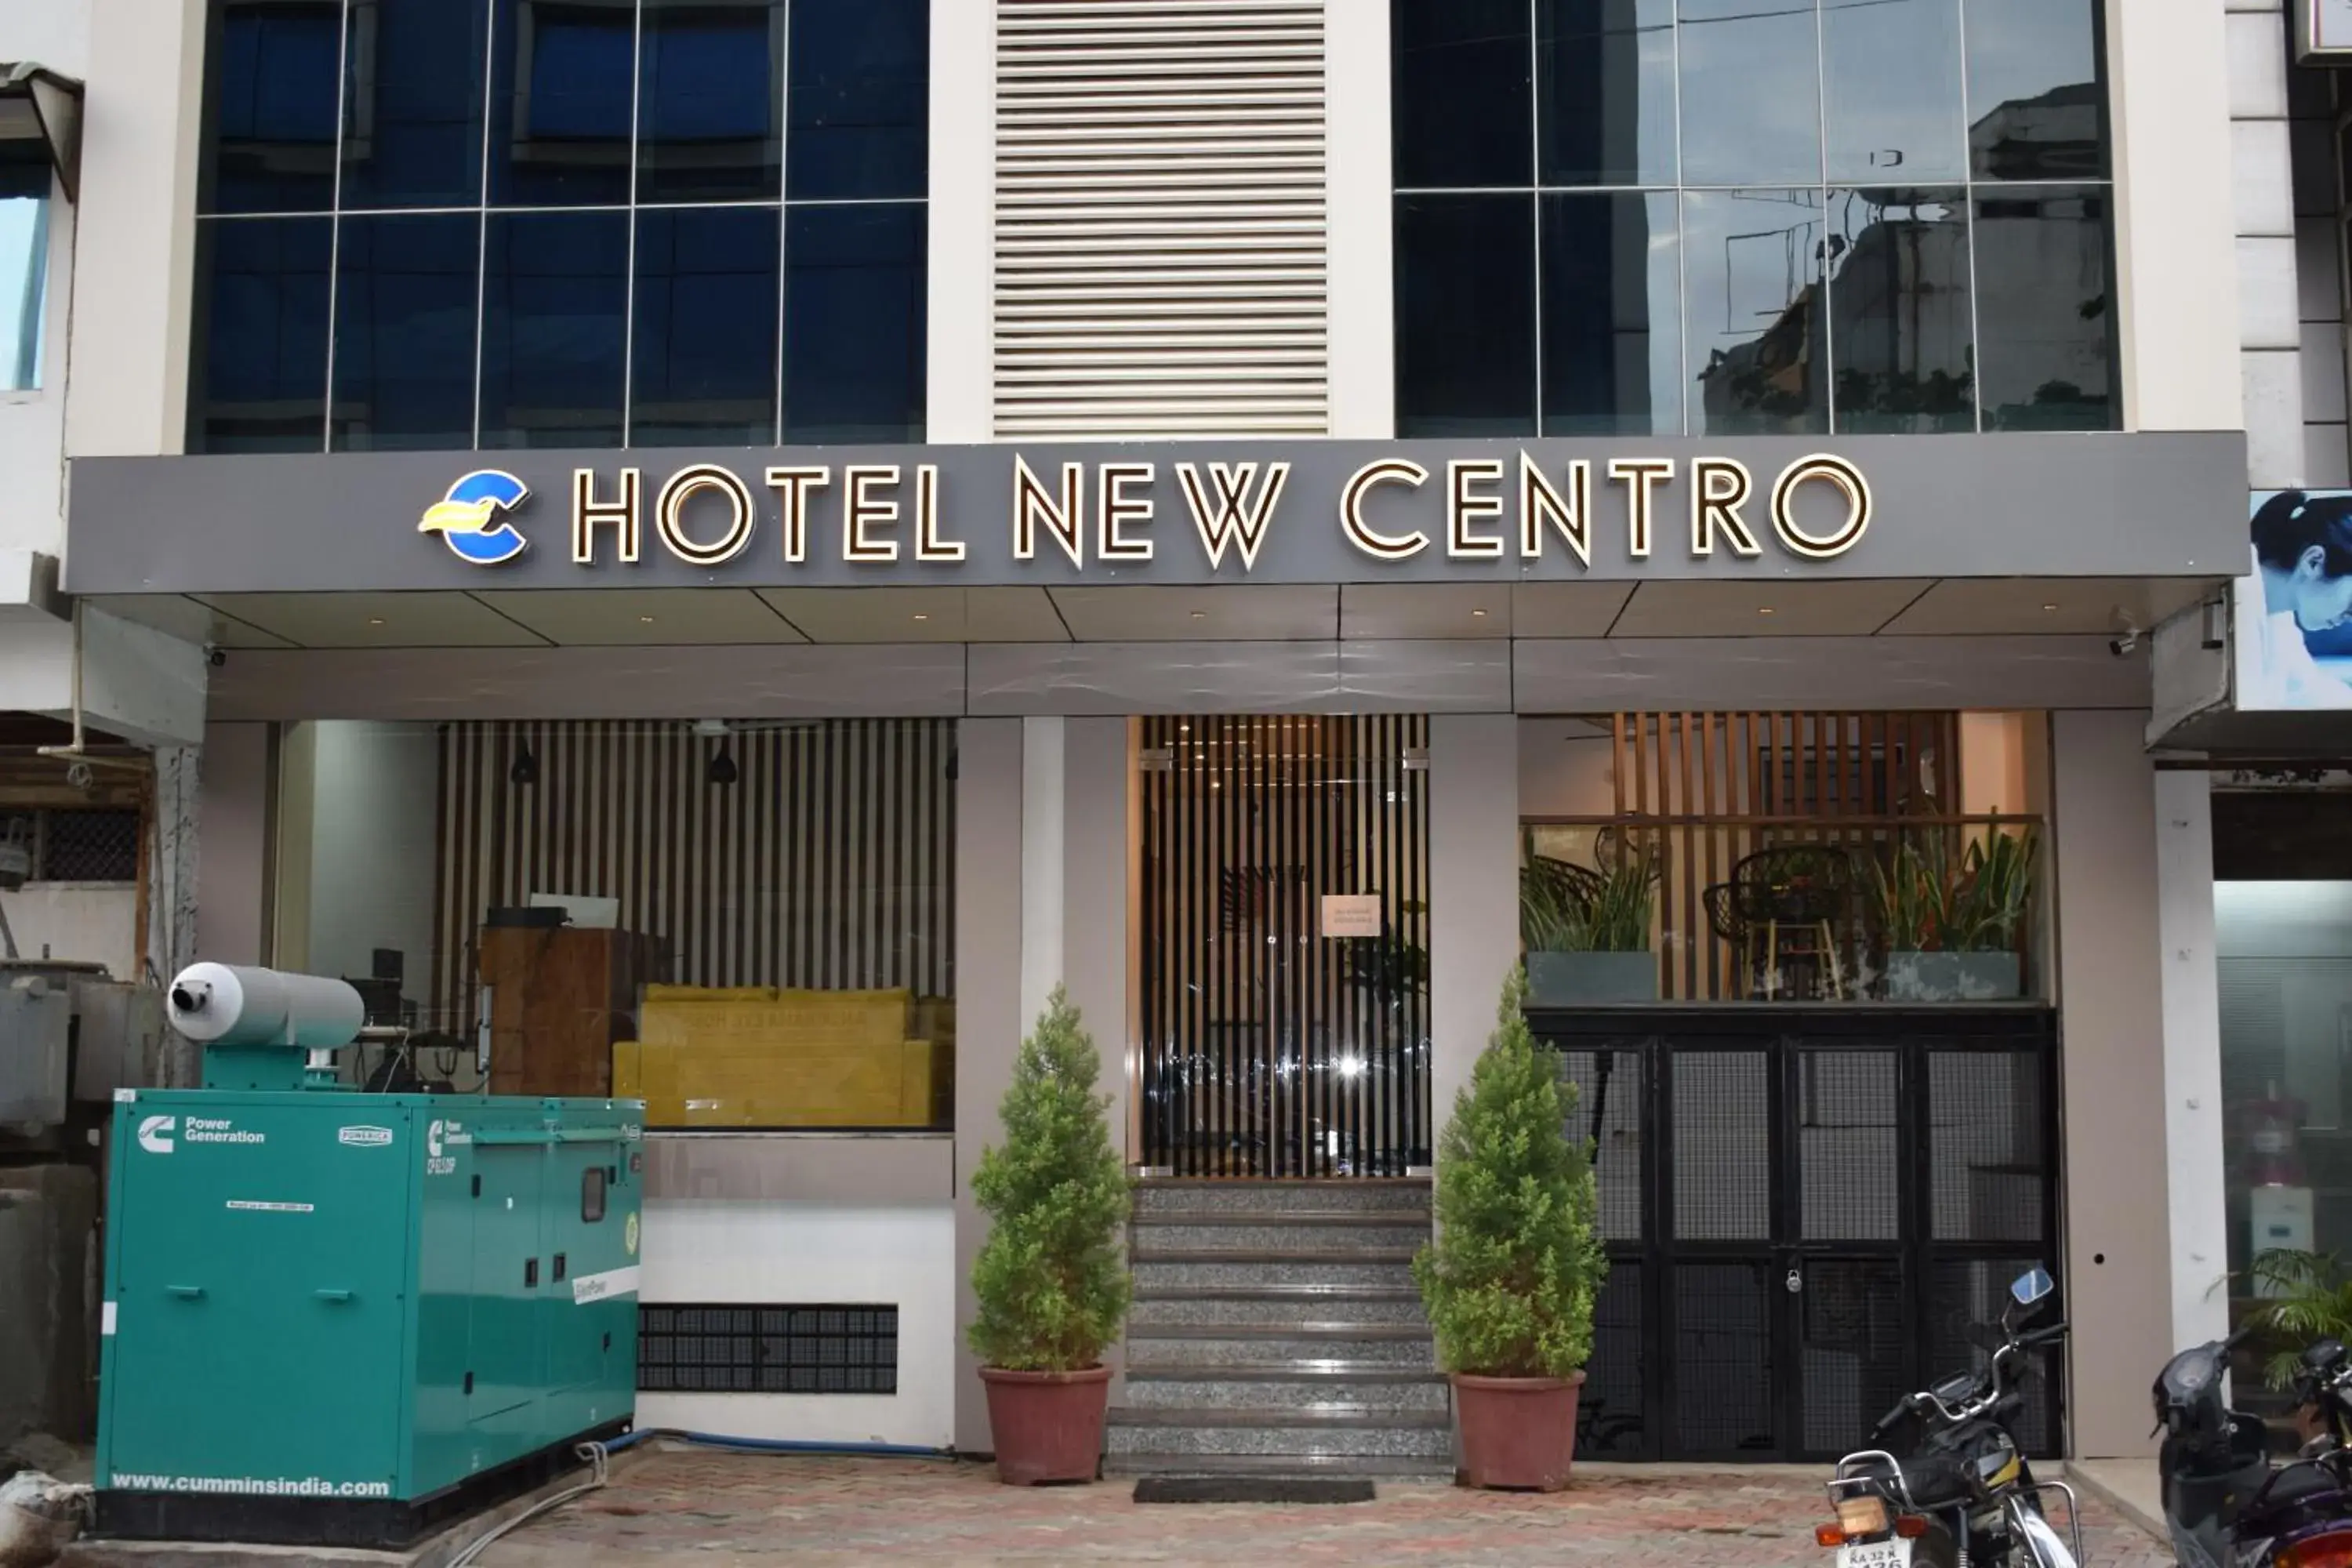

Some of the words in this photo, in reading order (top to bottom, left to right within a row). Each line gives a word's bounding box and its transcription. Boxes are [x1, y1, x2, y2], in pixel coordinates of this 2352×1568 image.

[572, 463, 966, 564] HOTEL
[1013, 452, 1290, 571] NEW
[1339, 449, 1872, 571] CENTRO
[185, 1116, 232, 1130] Power
[185, 1129, 266, 1143] Generation
[112, 1472, 390, 1496] www.cumminsindia.com
